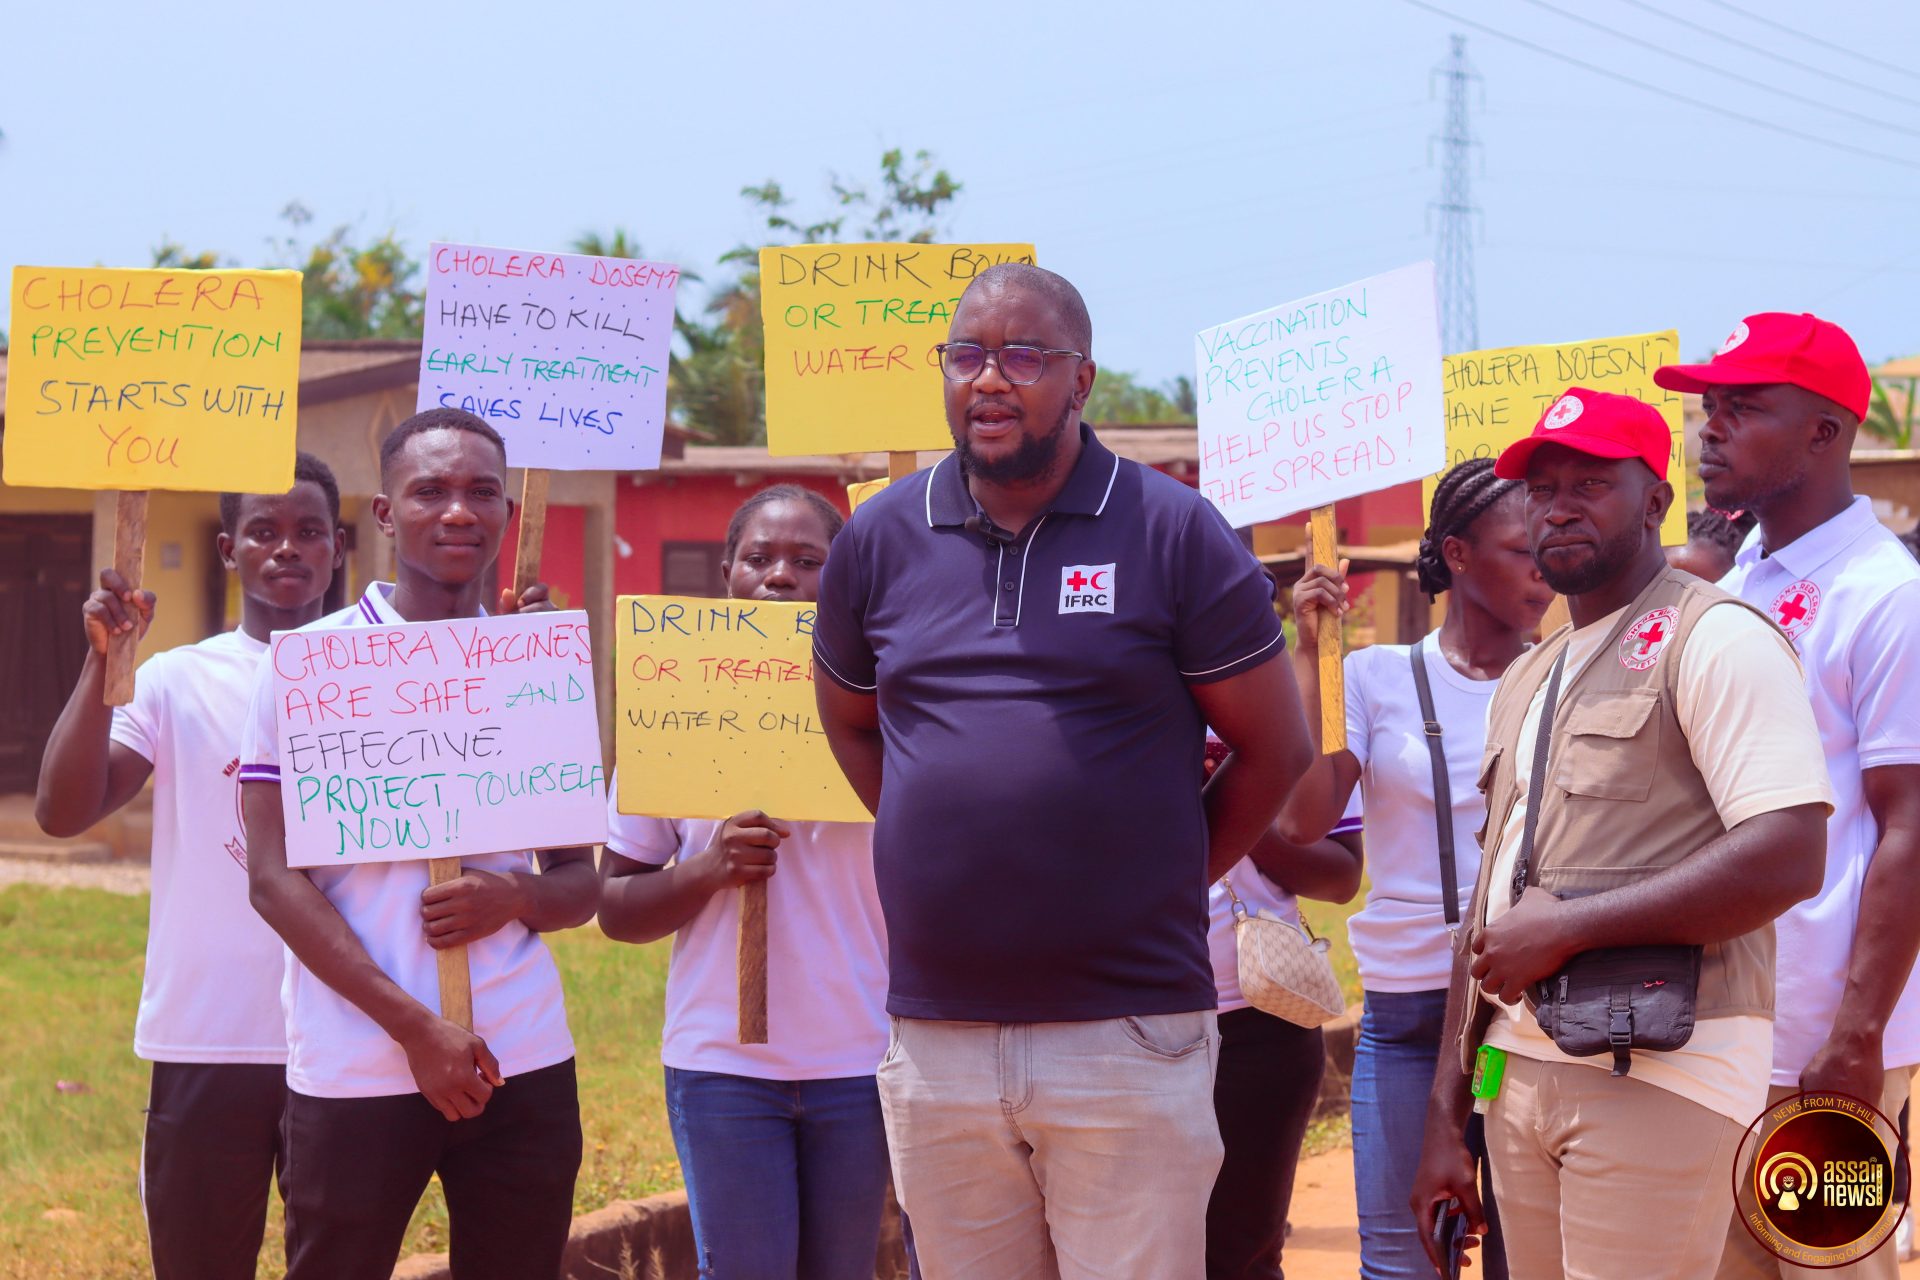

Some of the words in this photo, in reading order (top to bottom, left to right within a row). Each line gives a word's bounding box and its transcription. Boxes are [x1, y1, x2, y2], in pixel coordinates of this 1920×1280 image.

[436, 248, 566, 279] CHOLERA
[778, 252, 932, 289] DRINK
[22, 275, 264, 312] CHOLERA
[441, 299, 511, 331] HAVE
[521, 302, 556, 330] TO
[567, 309, 645, 341] KILL
[784, 302, 842, 330] OR
[855, 297, 961, 326] TREA
[1198, 287, 1368, 363] VACCINATION
[32, 324, 282, 361] PREVENTION
[794, 344, 914, 377] WATER
[1556, 337, 1671, 382] DOESN'T
[427, 348, 514, 375] EARLY
[521, 356, 659, 387] TREATMENT
[1206, 335, 1351, 404] PREVENTS
[36, 379, 191, 415] STARTS
[203, 385, 285, 421] WITH
[1246, 355, 1394, 421] CHOLERA
[539, 402, 623, 435] LIVES
[1203, 421, 1281, 470] HELP
[1293, 413, 1326, 448] US
[1341, 381, 1412, 429] STOP
[98, 424, 179, 468] YOU
[1203, 472, 1256, 506] THE
[1065, 594, 1107, 608] IFRC
[1769, 585, 1797, 613] GHANA
[1800, 582, 1815, 594] RED
[631, 600, 768, 639] DRINK
[1803, 595, 1818, 626] CROSS
[274, 630, 438, 681] CHOLERA
[447, 623, 594, 669] VACCINES
[632, 654, 681, 683] OR
[285, 682, 372, 726] ARE
[506, 673, 585, 709] AND
[628, 708, 746, 733] WATER
[758, 711, 827, 735] ONL
[297, 773, 446, 822] PROTECT
